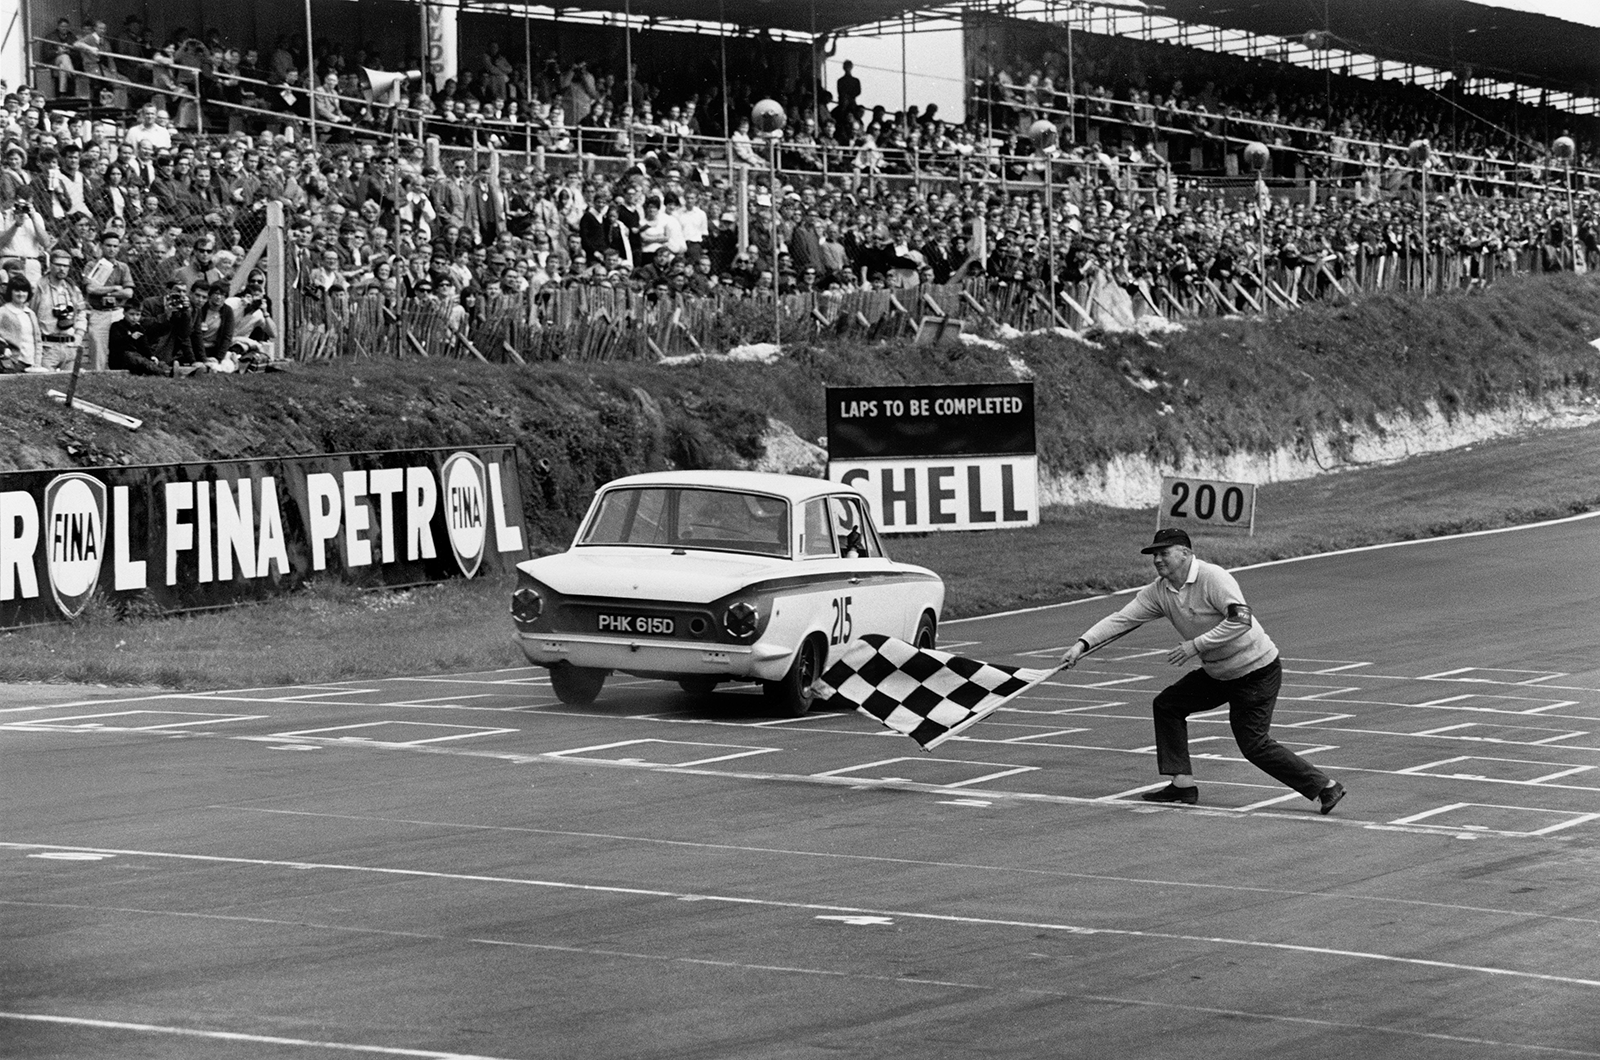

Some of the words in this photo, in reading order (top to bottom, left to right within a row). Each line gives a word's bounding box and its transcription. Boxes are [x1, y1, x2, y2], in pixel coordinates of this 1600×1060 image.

[840, 401, 878, 418] LAPS
[883, 400, 904, 417] TO
[910, 399, 930, 416] BE
[934, 397, 1023, 415] COMPLETED
[838, 463, 1029, 531] SHELL
[1169, 481, 1244, 523] 200
[165, 475, 290, 587] FINA
[598, 614, 632, 632] PHK
[635, 616, 674, 634] 615D
[830, 595, 852, 646] 215
